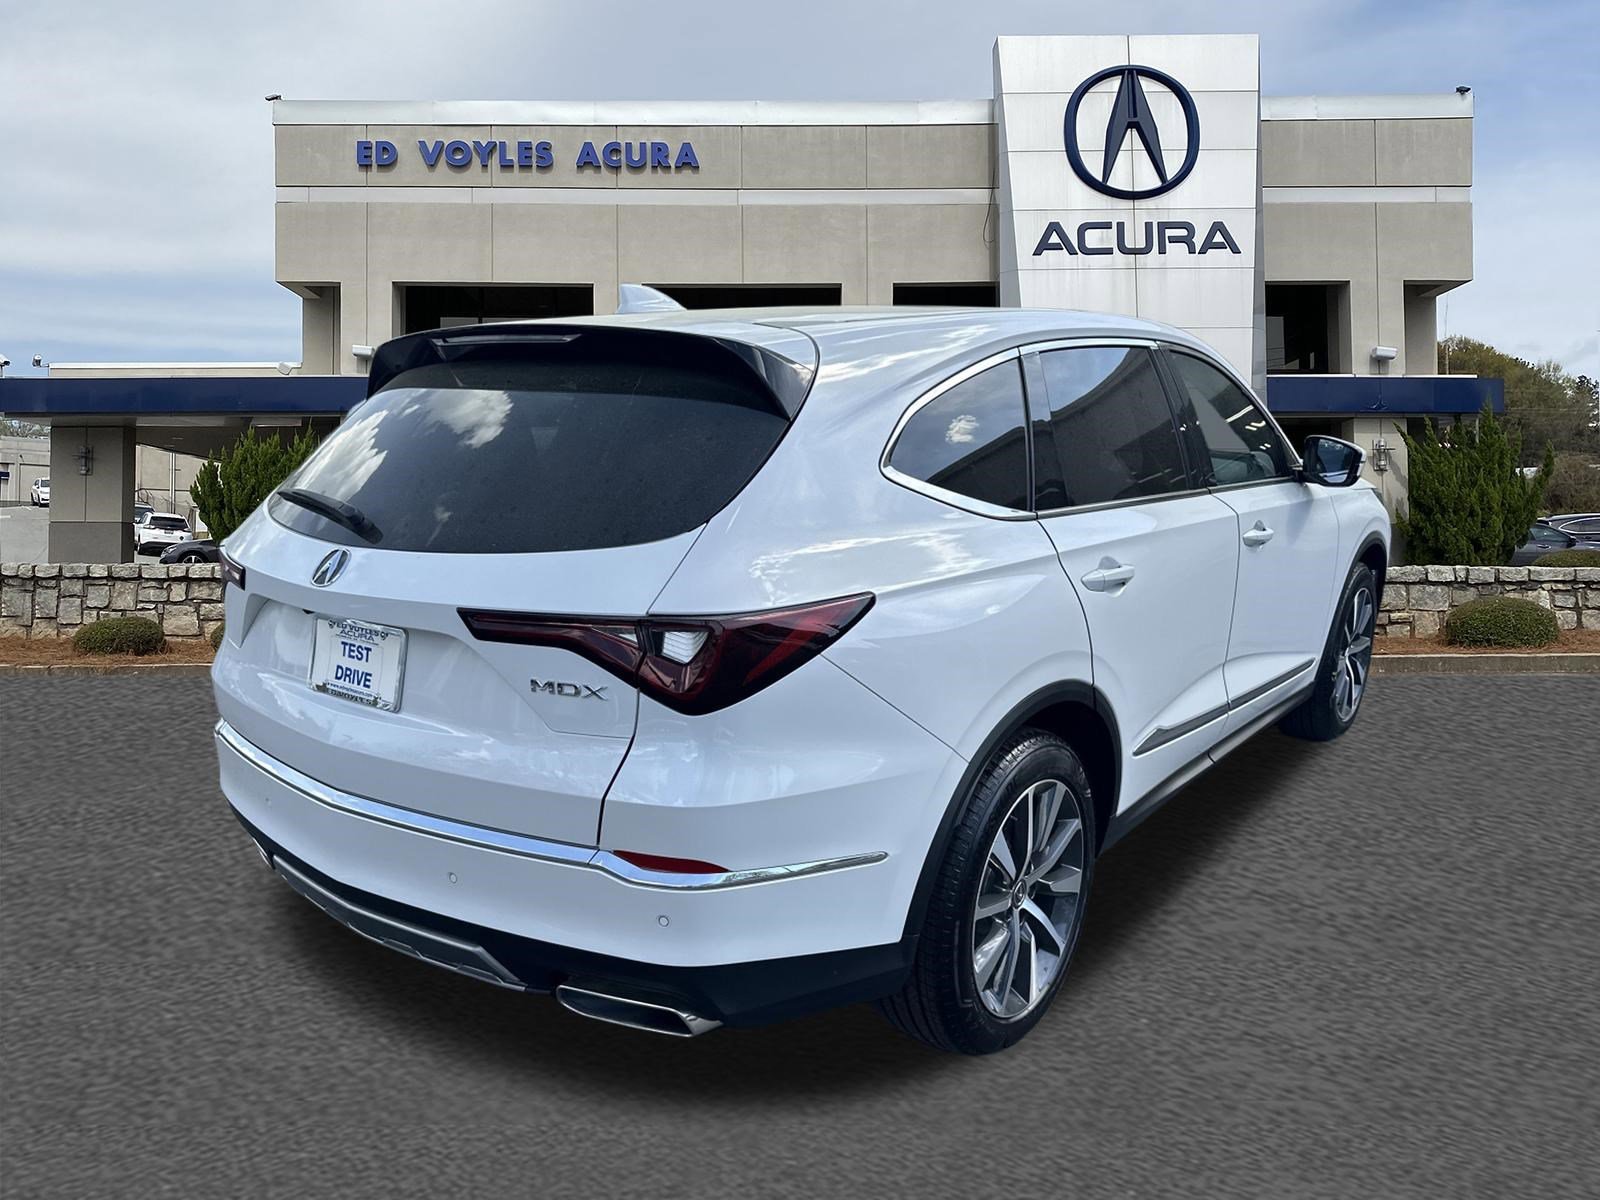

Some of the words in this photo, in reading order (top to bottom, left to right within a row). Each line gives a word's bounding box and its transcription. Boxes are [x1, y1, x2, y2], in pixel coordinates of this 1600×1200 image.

[356, 140, 398, 168] ED
[418, 140, 554, 169] VOYLES
[576, 140, 700, 169] ACURA
[1032, 221, 1242, 256] ACURA
[340, 629, 375, 642] ACURA
[341, 641, 372, 663] TEST
[334, 664, 372, 689] DRIVE
[530, 678, 609, 701] MDX
